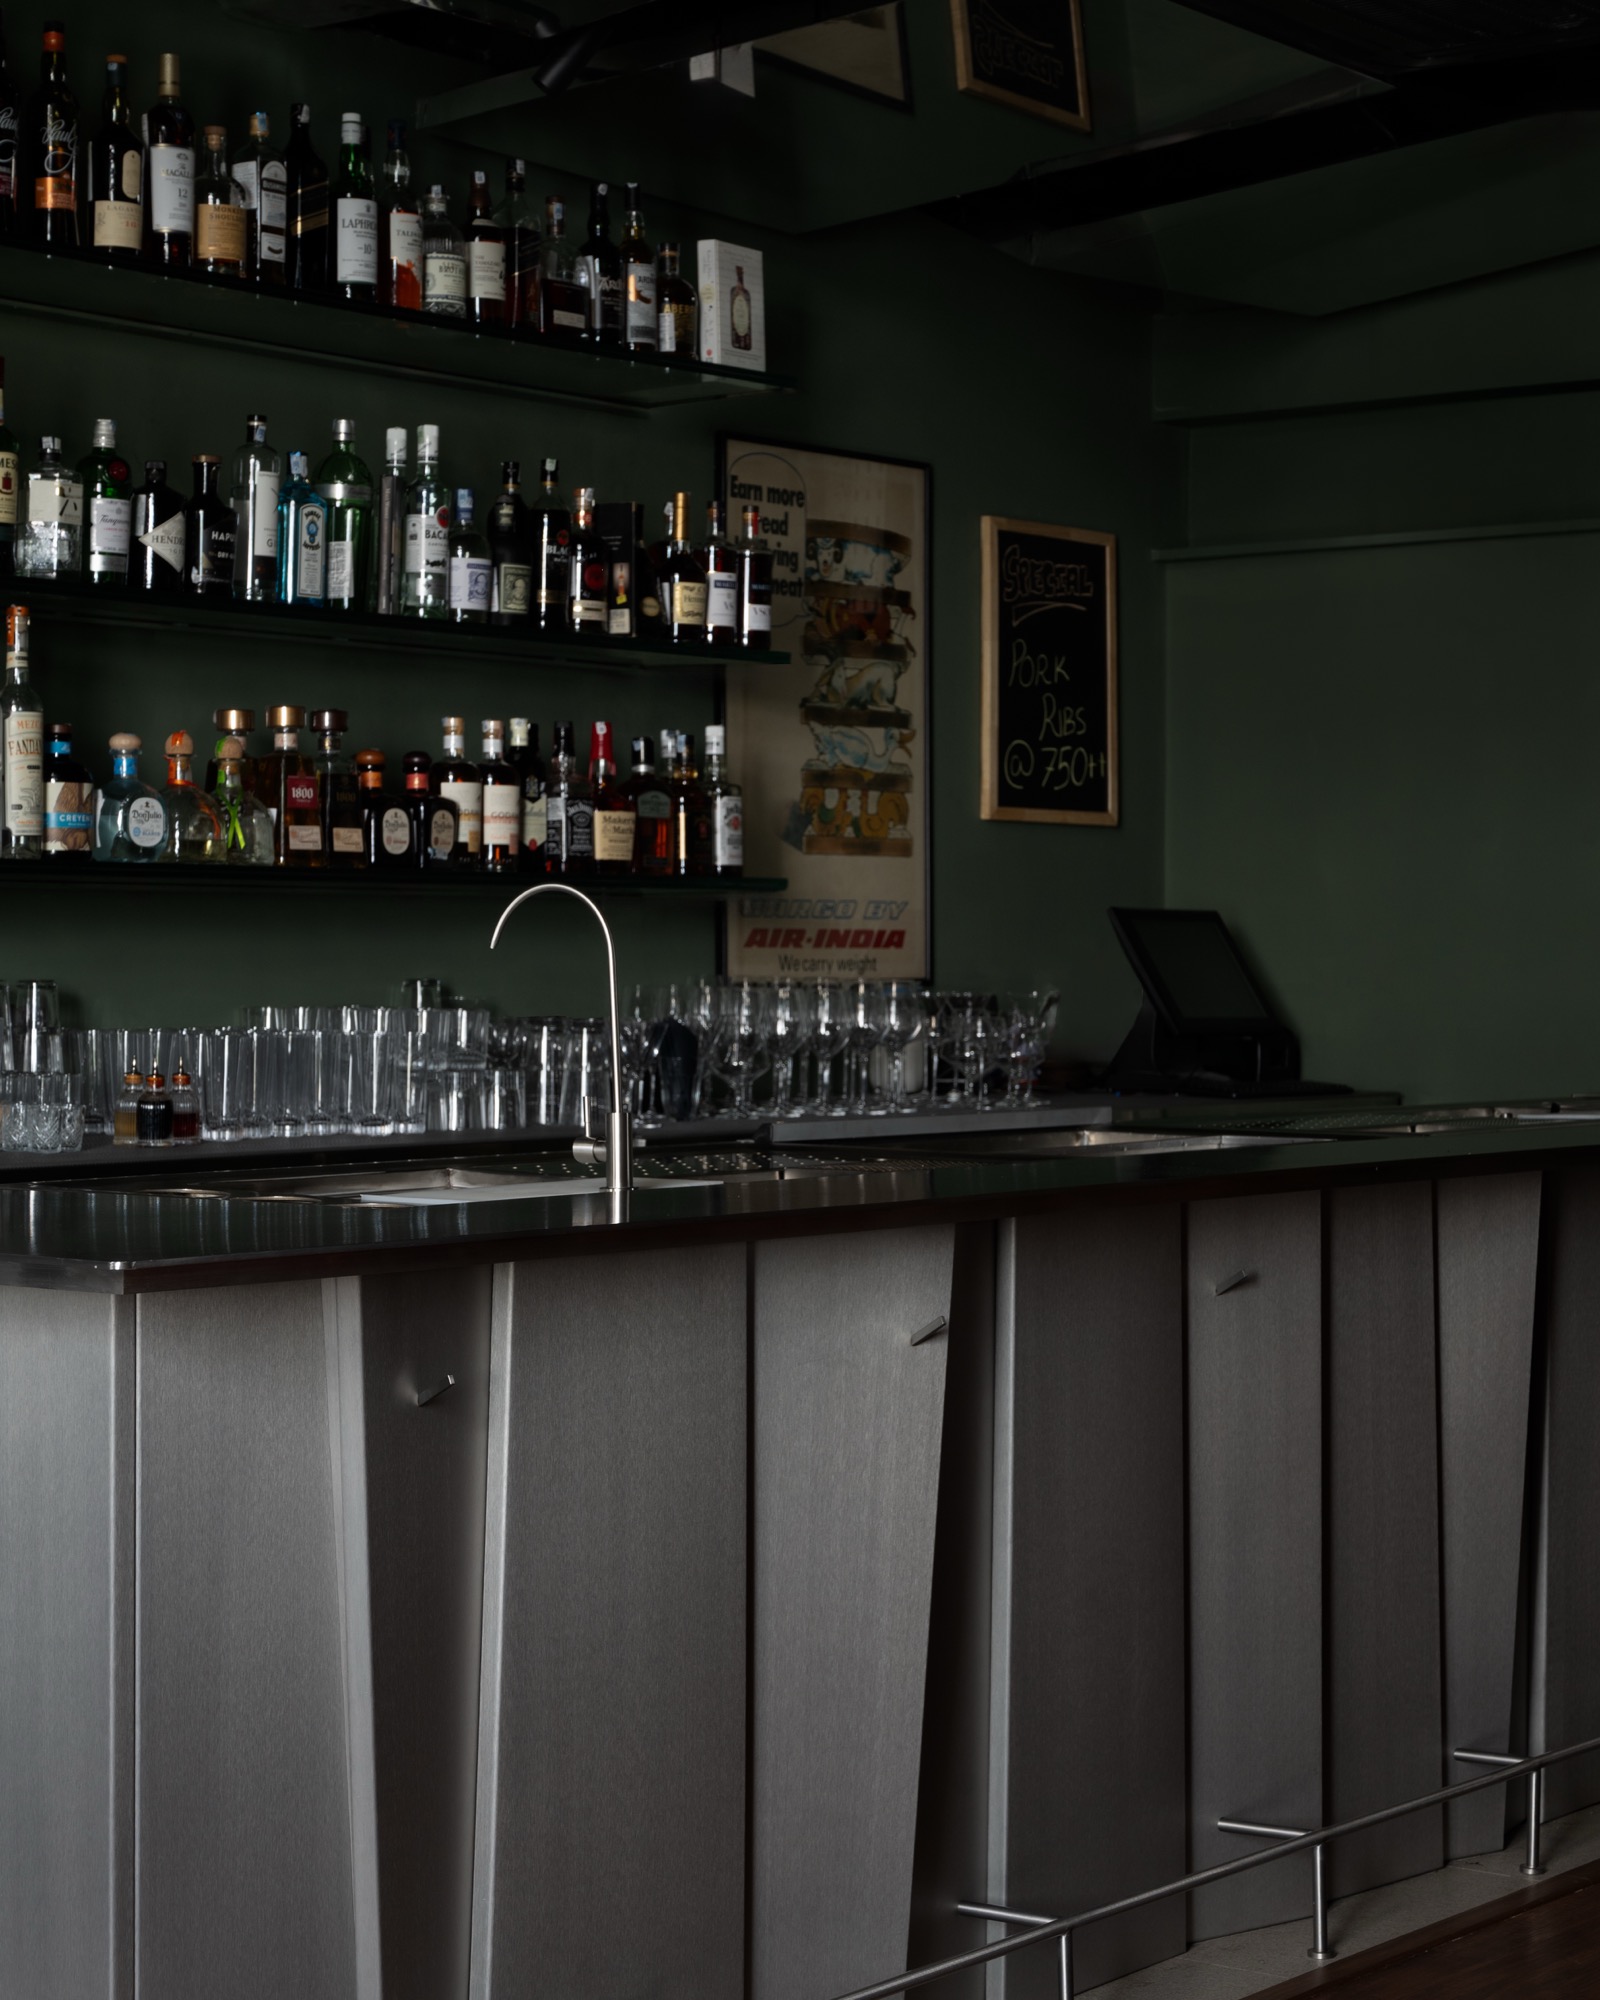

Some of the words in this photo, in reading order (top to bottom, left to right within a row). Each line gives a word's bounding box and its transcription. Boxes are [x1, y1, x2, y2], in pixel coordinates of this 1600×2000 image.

[730, 475, 763, 502] Earn
[767, 486, 805, 508] more
[1008, 638, 1070, 687] PORK
[1038, 692, 1086, 741] RIBS
[1004, 740, 1034, 789] @
[291, 787, 314, 799] 1800
[863, 900, 909, 920] BY
[778, 955, 801, 972] We
[801, 957, 834, 974] carry
[835, 956, 877, 975] weight
